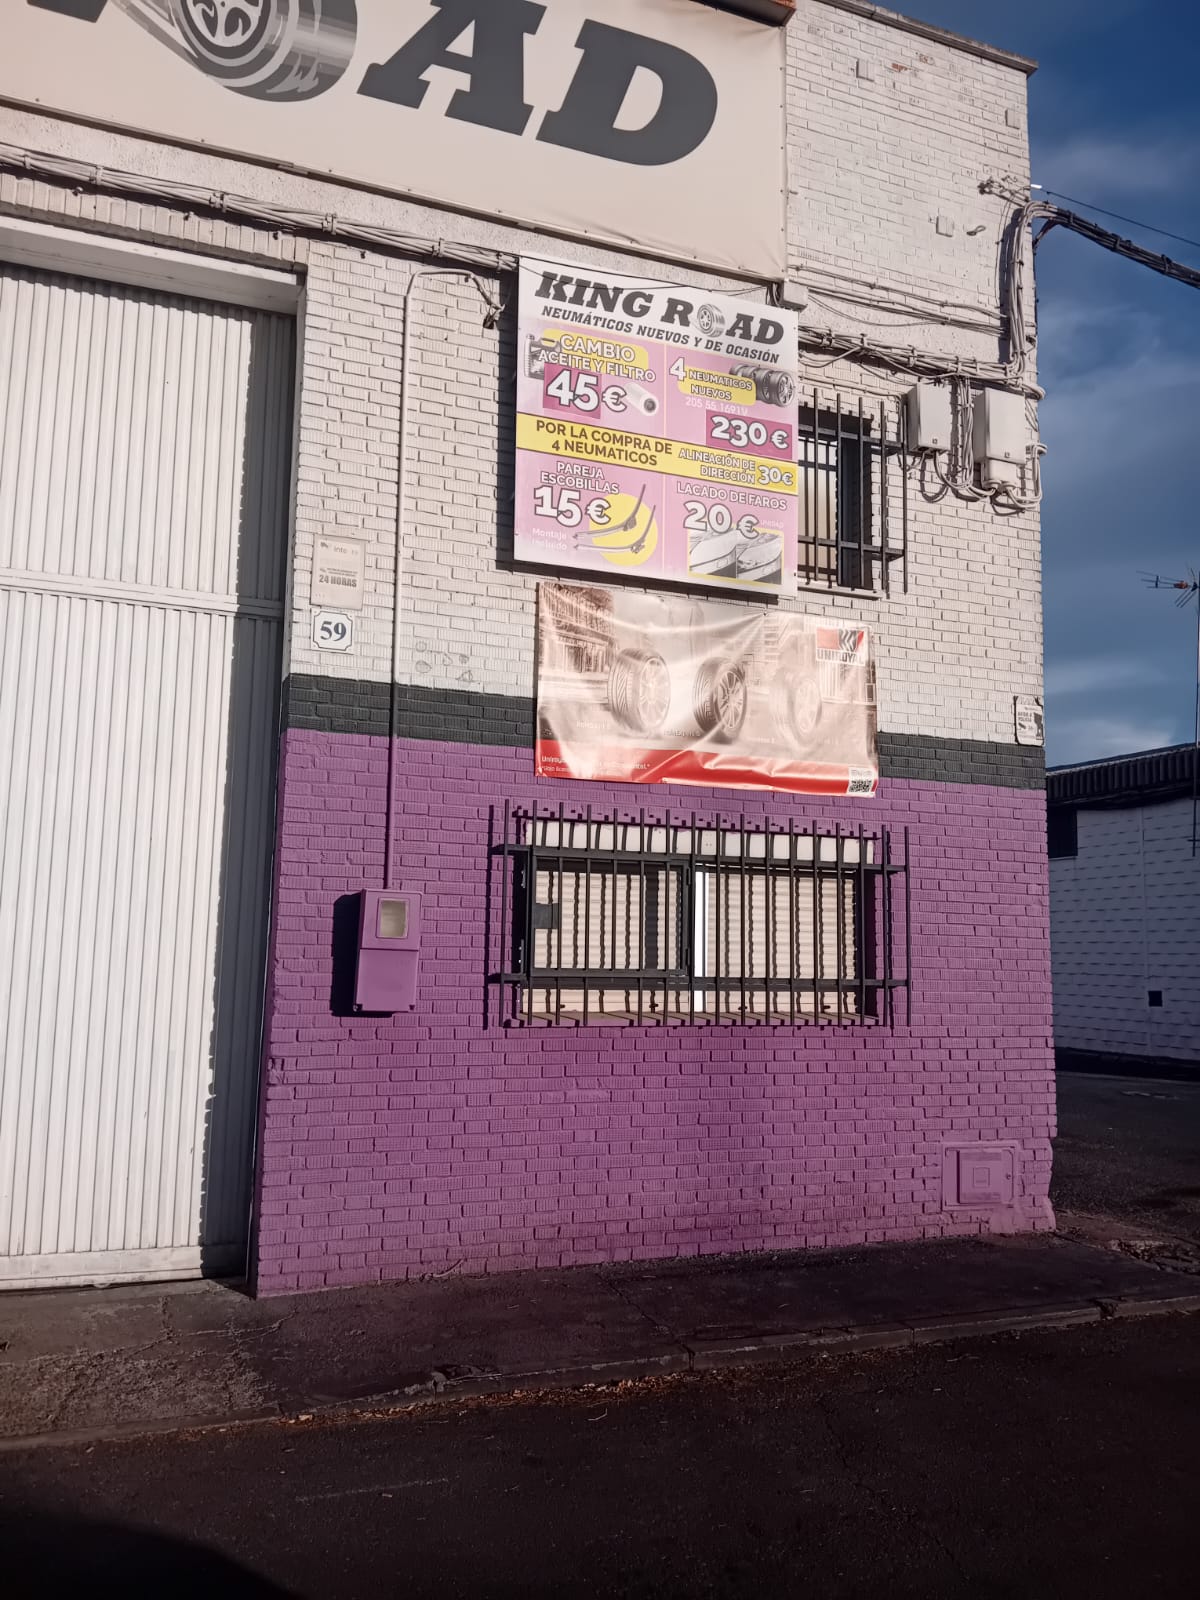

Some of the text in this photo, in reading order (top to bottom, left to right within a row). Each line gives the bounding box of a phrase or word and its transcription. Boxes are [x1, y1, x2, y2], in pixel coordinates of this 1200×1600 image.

[535, 270, 654, 318] KING
[541, 305, 780, 364] NEUMÁTICOS NUEVOS Y DE OCASIÓN
[560, 334, 635, 362] CAMBIO
[538, 350, 657, 382] ACEITE Y FILTRO
[669, 357, 753, 391] 4 NEUMATICOS
[686, 396, 703, 408] 205
[691, 383, 732, 401] NUEVOS
[536, 420, 673, 455] POR LA COMPRA DE
[552, 439, 658, 466] 4 NEUMATICOS
[679, 448, 756, 471] ALINEACIÓN DE
[541, 471, 620, 494] ESCOBILLAS
[556, 461, 605, 480] PAREJA
[700, 465, 755, 484] DIRECCIÓN
[677, 480, 788, 511] LACADO DE FAROS
[318, 574, 329, 584] 24
[320, 621, 347, 642] 59
